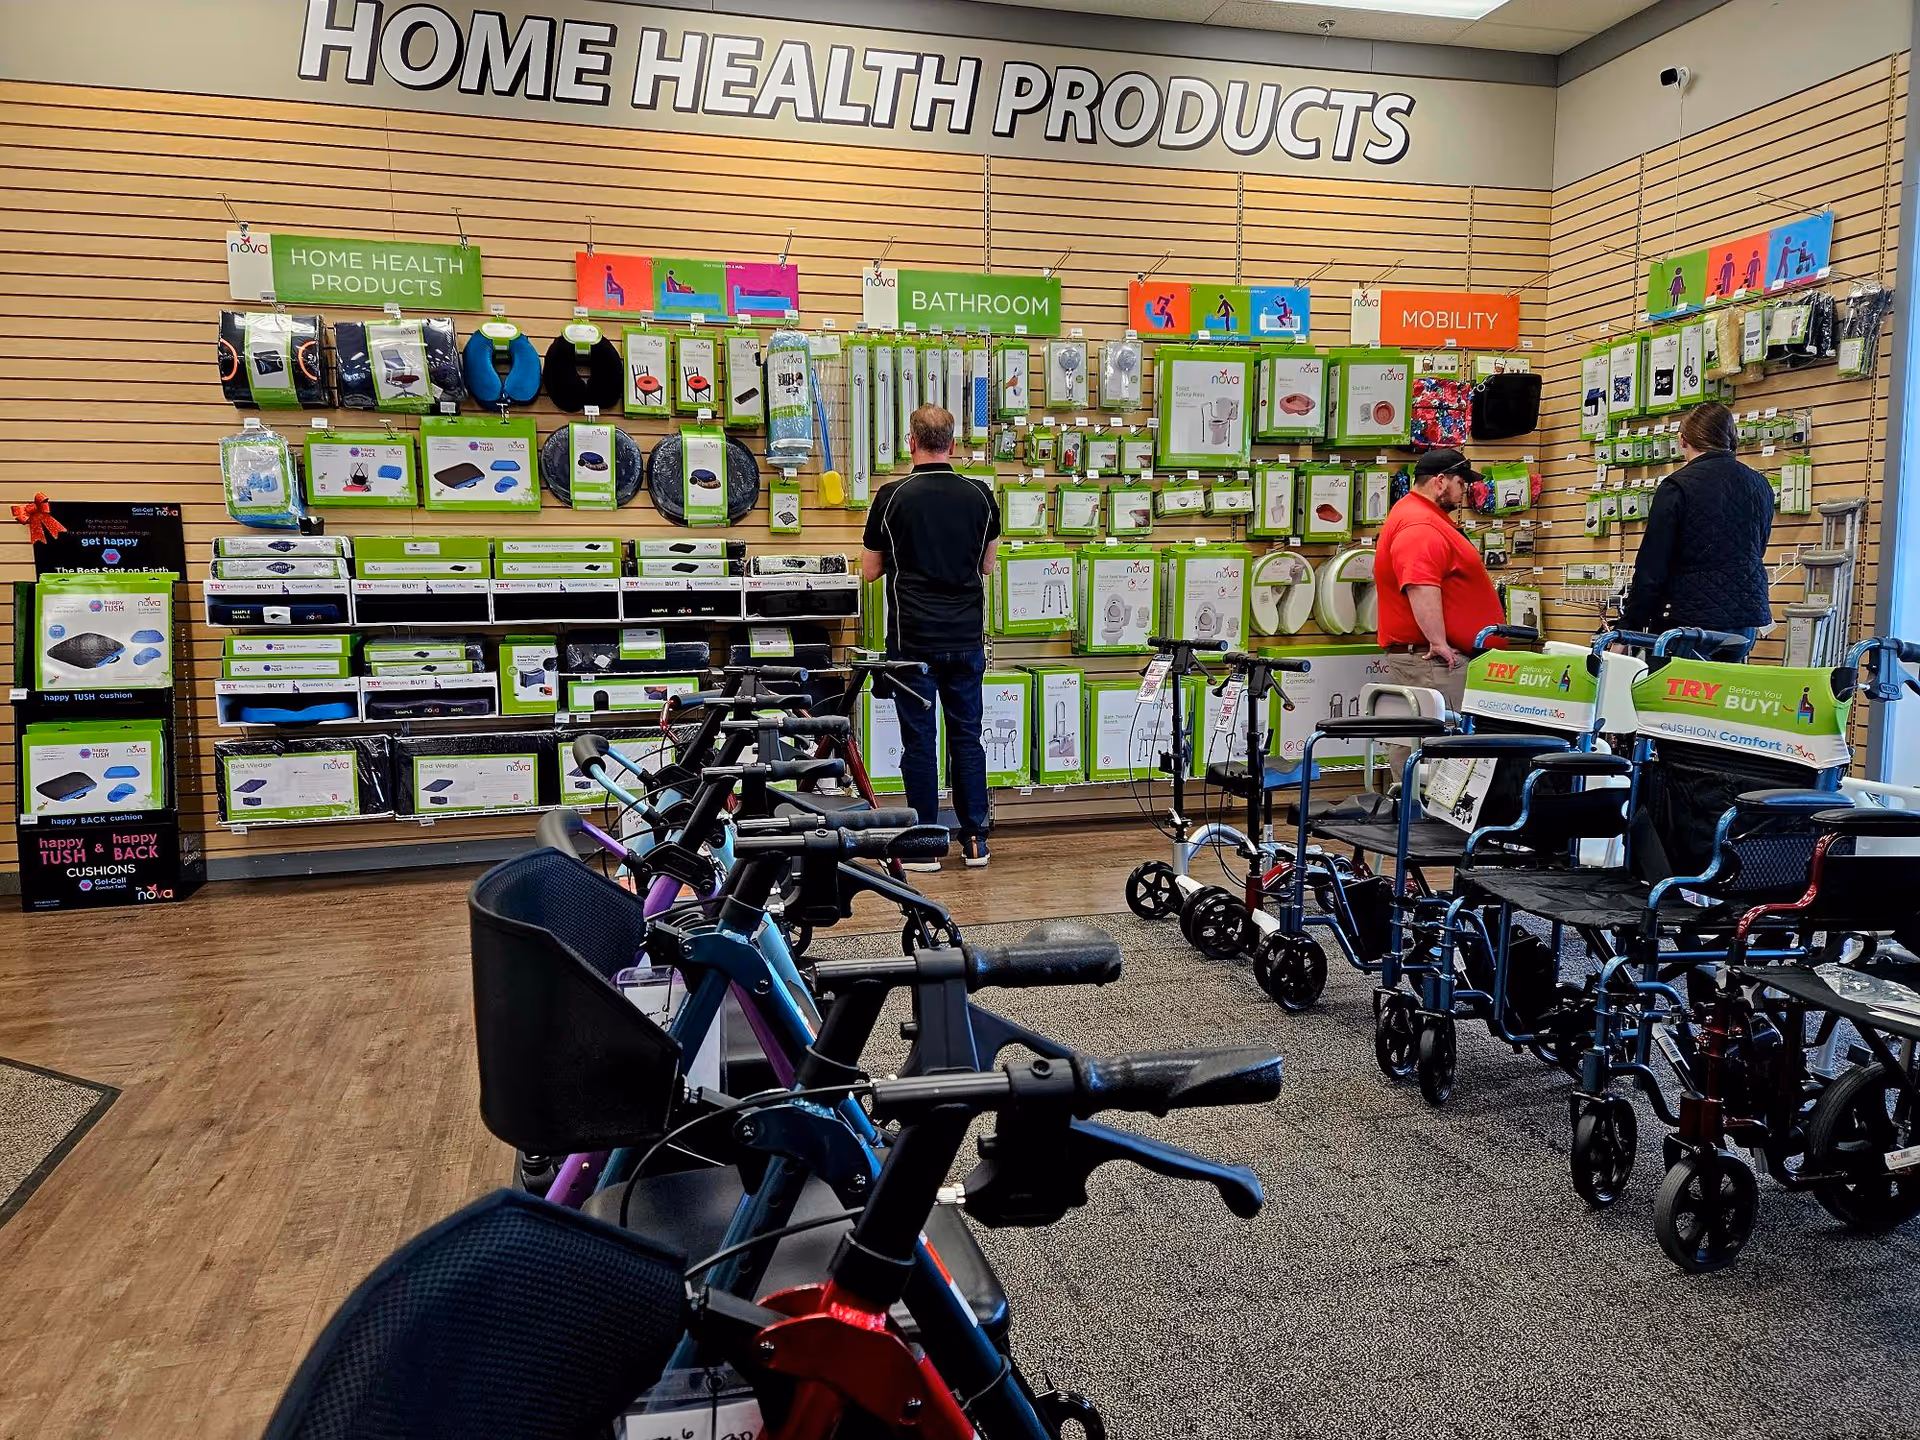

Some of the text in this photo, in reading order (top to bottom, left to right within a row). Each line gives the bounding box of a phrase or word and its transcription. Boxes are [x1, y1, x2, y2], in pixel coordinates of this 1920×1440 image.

[298, 0, 1416, 165] HOME HEALTH PRODUCTS
[230, 237, 268, 254] nova
[292, 248, 463, 274] HOME HEALTH
[312, 274, 443, 297] PRODUCTS
[866, 274, 896, 288] nova
[912, 290, 1049, 316] BATHROOM
[1353, 296, 1378, 307] nova
[1402, 310, 1498, 330] MOBILITY
[740, 342, 758, 350] nova
[1300, 366, 1319, 374] nova
[1380, 368, 1404, 380] nova
[1212, 372, 1239, 384] nova
[508, 442, 525, 450] nova
[1329, 479, 1346, 488] nova
[156, 507, 178, 516] nova
[81, 537, 138, 546] get happy
[1044, 564, 1070, 576] nova
[1126, 564, 1150, 574] nova
[1216, 569, 1238, 578] nova
[138, 598, 161, 606] nova
[1488, 662, 1520, 679] TRY
[1062, 678, 1077, 686] nova
[1519, 674, 1551, 688] BUY!
[1666, 679, 1722, 700] TRY
[1728, 685, 1782, 699] Before You
[44, 694, 70, 702] happy
[996, 691, 1018, 702] nova
[1478, 700, 1565, 718] CUSHION Comfort nova
[1724, 694, 1780, 716] BUY!
[1660, 722, 1816, 762] CUSHION Comfort nova
[126, 746, 146, 754] nova
[323, 760, 349, 770] nova
[435, 762, 458, 770] Wedge
[506, 762, 531, 772] nova
[51, 814, 142, 826] happy BACK cushion
[39, 833, 157, 853] happy & happy
[40, 846, 159, 865] TUSH BACK
[66, 864, 136, 878] CUSHIONS
[138, 886, 174, 900] nova
